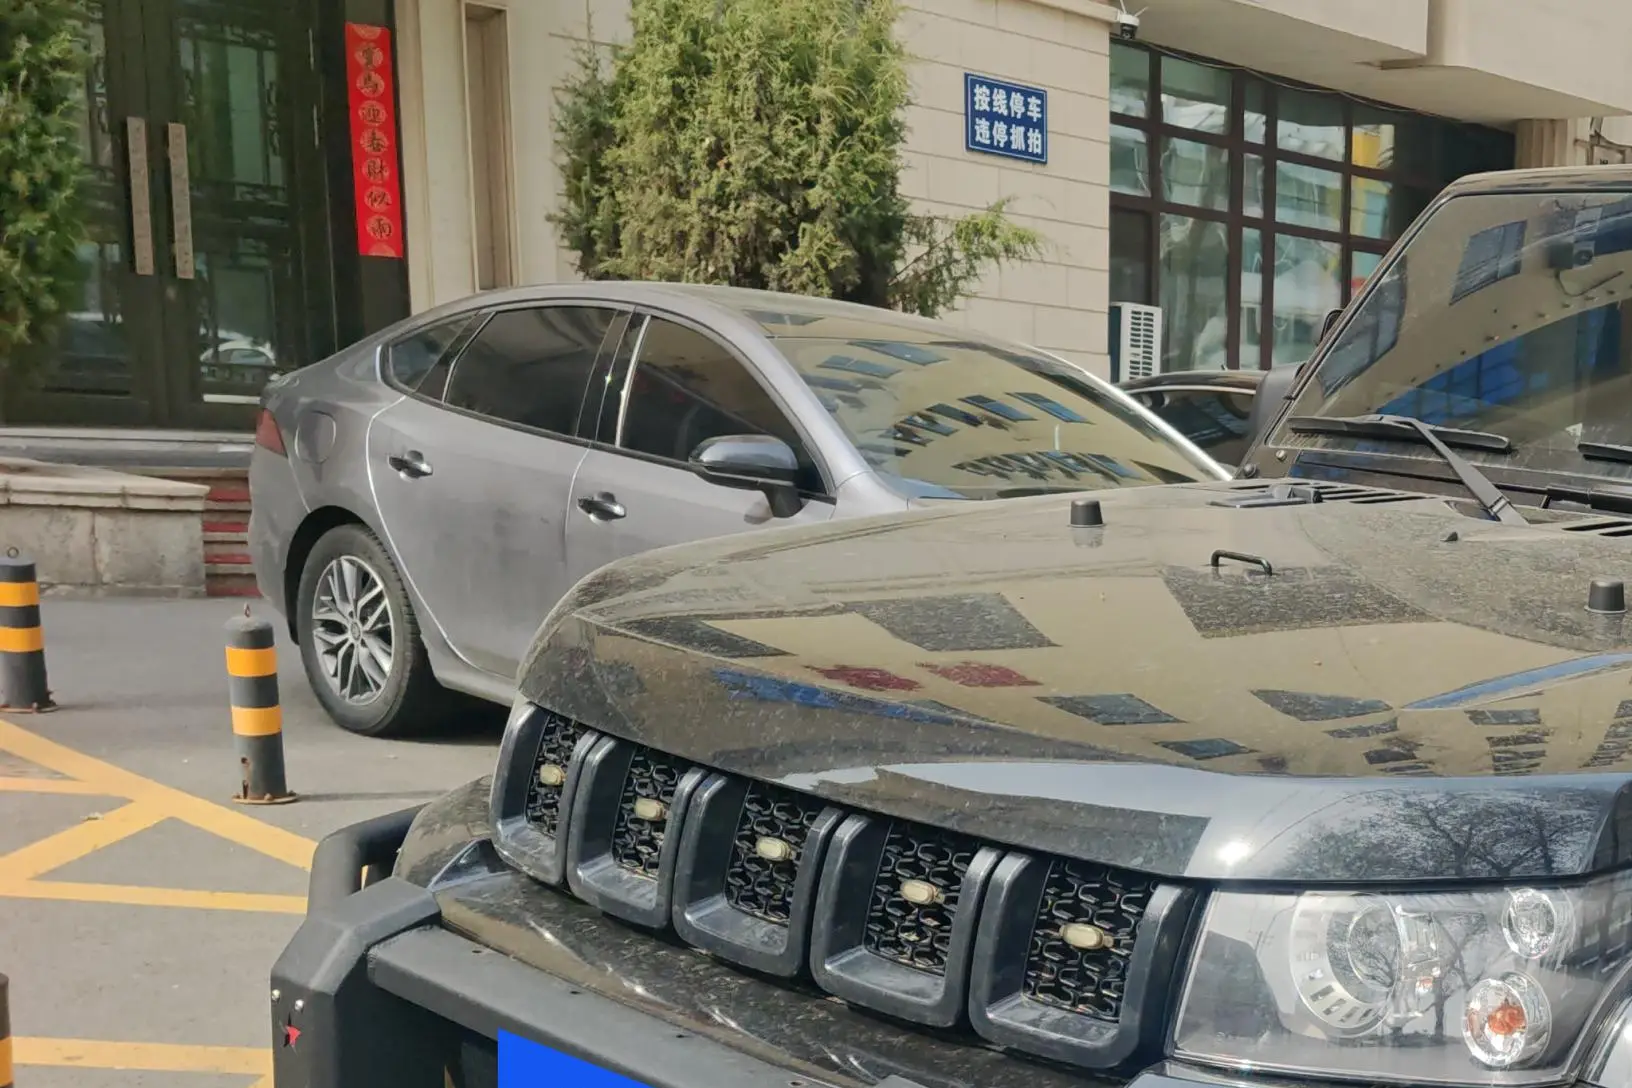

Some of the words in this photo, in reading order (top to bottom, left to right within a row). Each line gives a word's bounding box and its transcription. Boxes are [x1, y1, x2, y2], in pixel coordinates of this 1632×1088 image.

[973, 83, 1042, 122] 按线停车
[974, 117, 1042, 155] 违停抓拍
